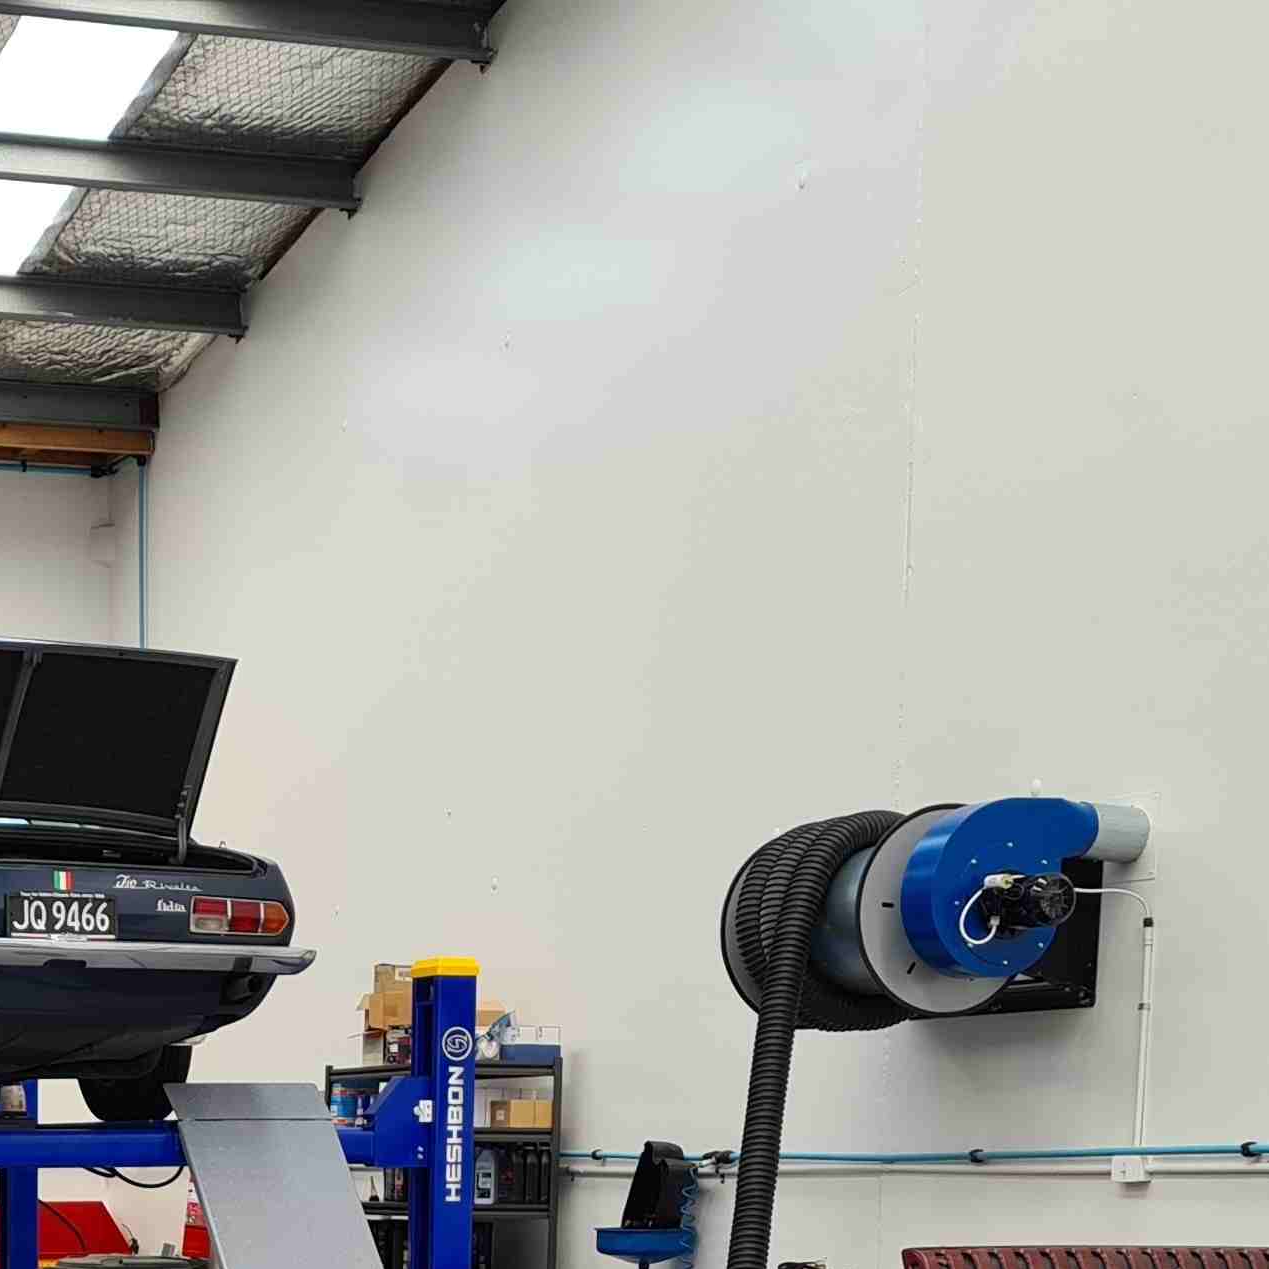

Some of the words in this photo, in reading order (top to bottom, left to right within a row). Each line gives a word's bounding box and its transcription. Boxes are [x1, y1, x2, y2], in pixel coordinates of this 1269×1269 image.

[12, 899, 46, 930] JQ
[52, 901, 110, 931] 9466
[445, 1066, 464, 1202] HESHBON
